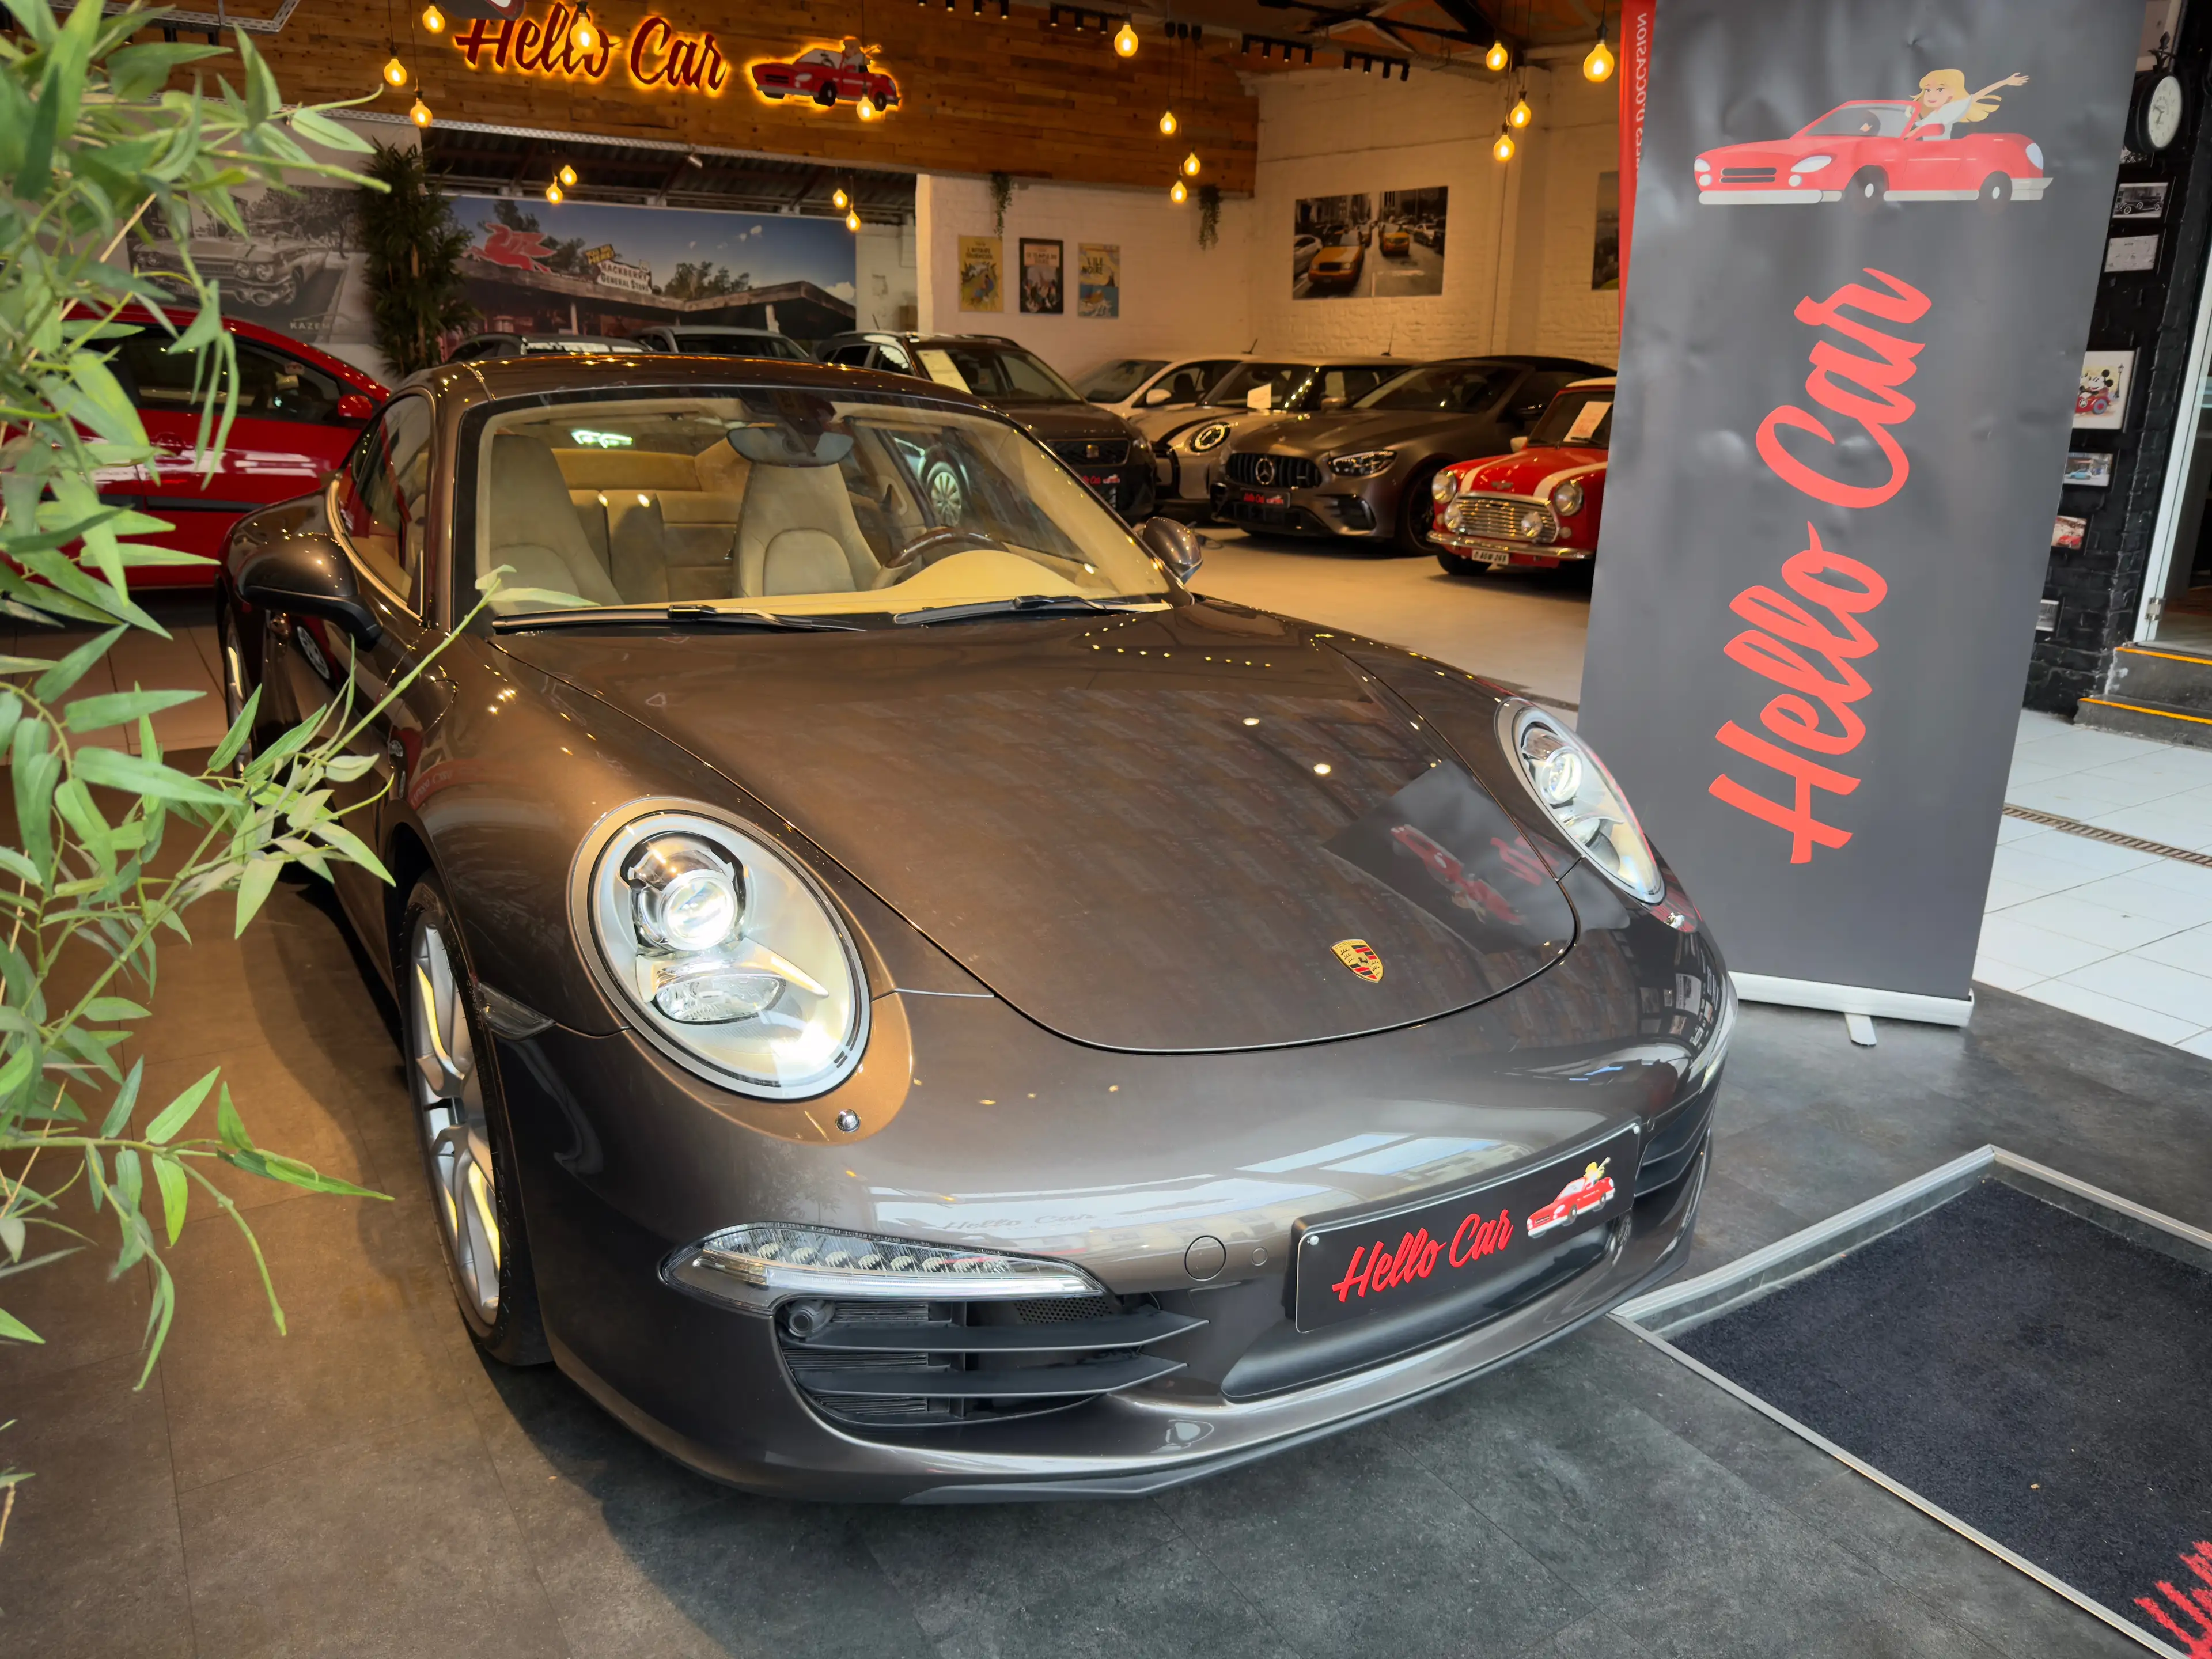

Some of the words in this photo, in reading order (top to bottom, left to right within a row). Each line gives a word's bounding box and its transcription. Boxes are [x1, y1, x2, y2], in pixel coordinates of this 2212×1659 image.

[631, 17, 728, 91] Car
[1756, 267, 1932, 508] Car
[1708, 520, 1888, 863] Hello
[1332, 1228, 1446, 1302] Hello
[1449, 1209, 1513, 1268] Car
